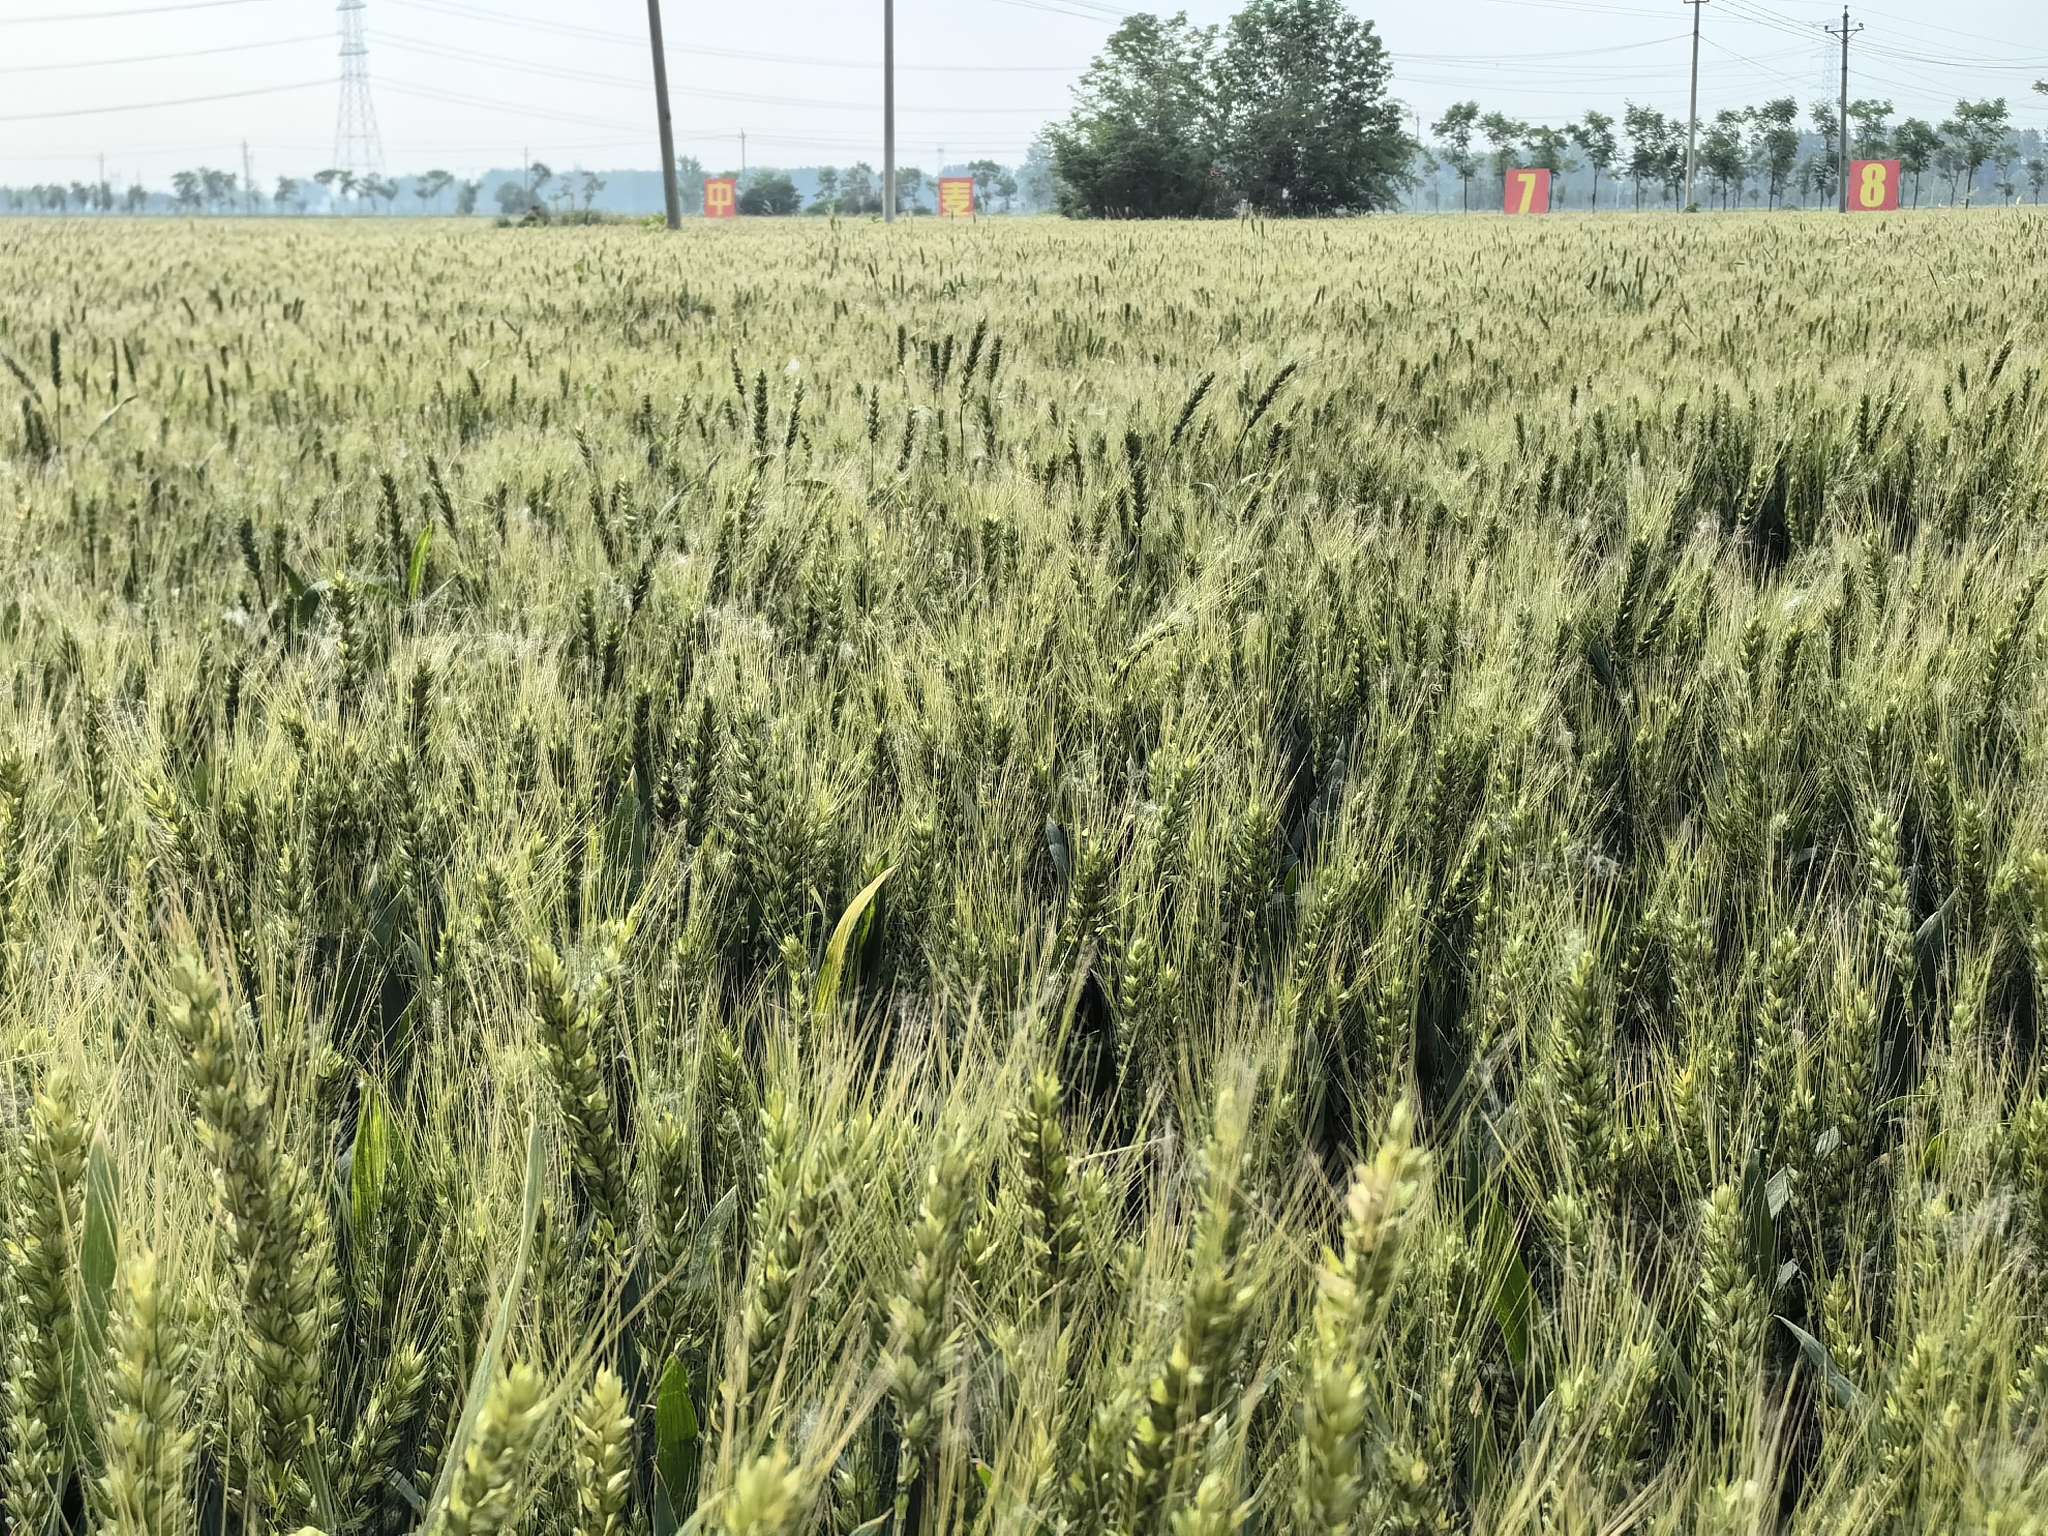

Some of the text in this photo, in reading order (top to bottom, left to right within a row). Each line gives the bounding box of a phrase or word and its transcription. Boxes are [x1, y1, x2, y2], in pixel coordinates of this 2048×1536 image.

[707, 182, 732, 216] 中
[943, 181, 970, 216] 麦
[1517, 173, 1536, 215] 7
[1860, 163, 1886, 207] 8
